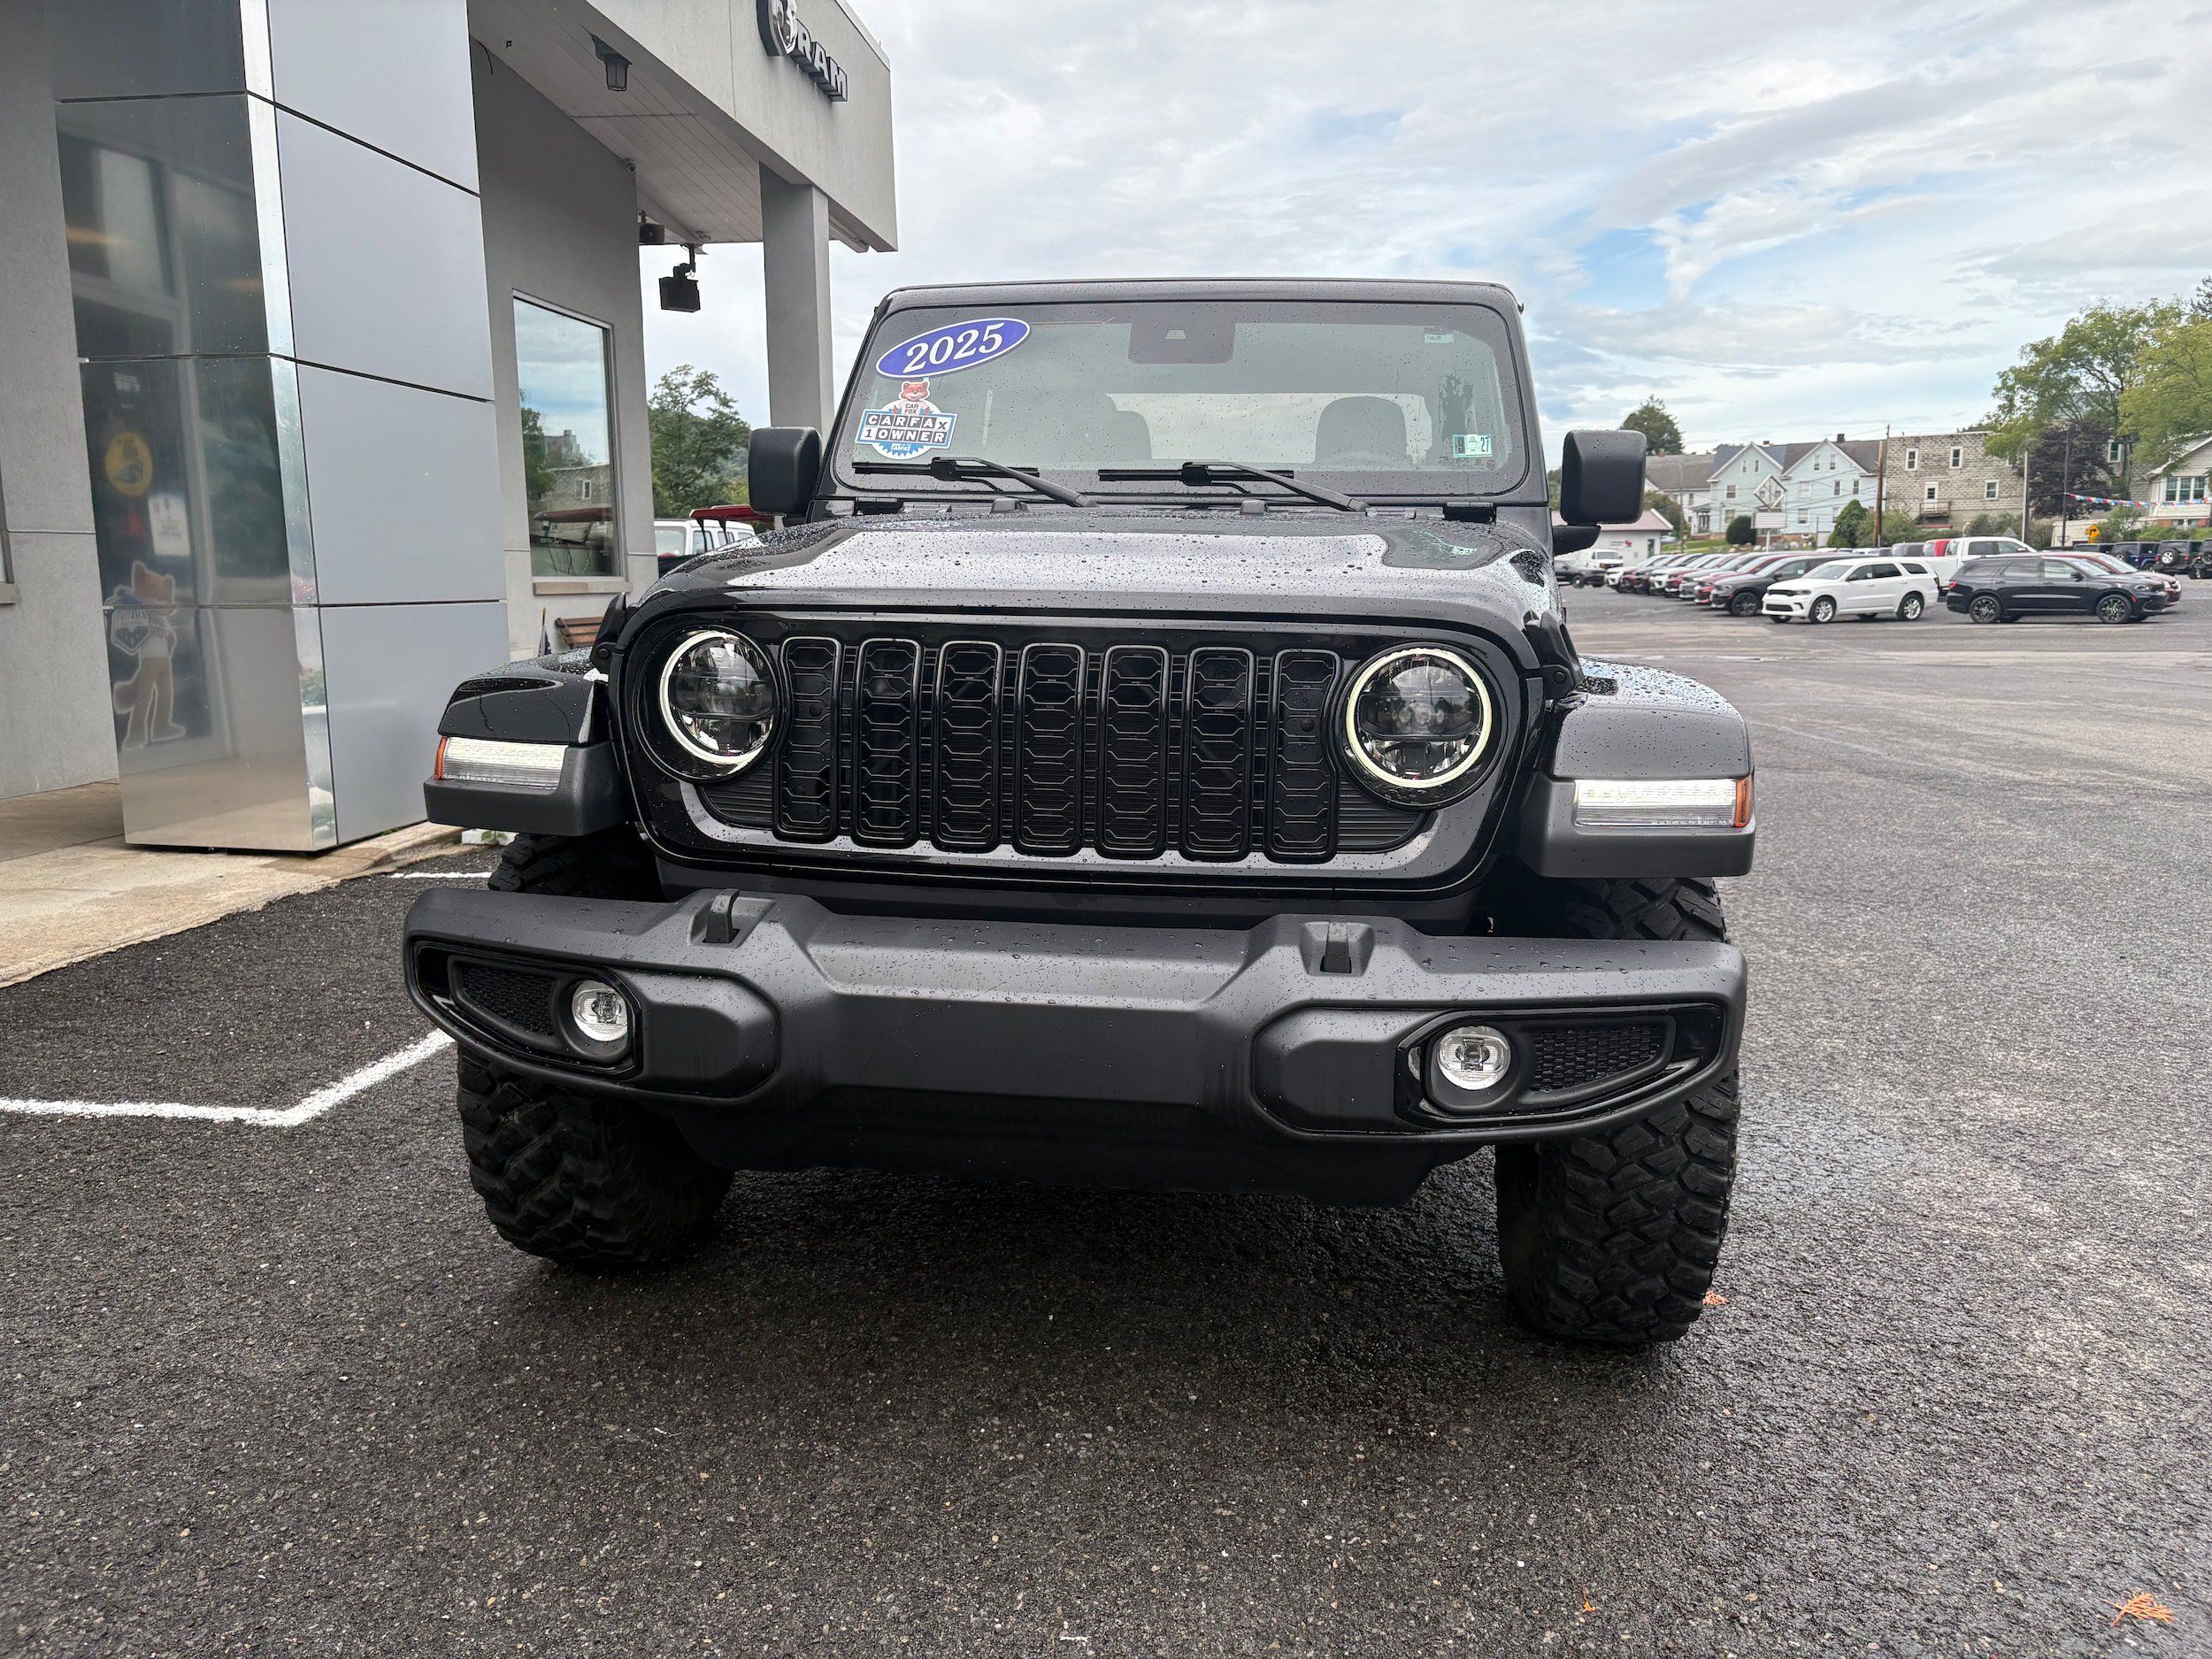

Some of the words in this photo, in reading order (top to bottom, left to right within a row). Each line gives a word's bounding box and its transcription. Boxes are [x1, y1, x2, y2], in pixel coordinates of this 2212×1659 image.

[796, 19, 848, 102] RAM
[902, 322, 1005, 373] 2025
[867, 414, 949, 430] CARFAX
[878, 429, 946, 442] OWNER
[1480, 436, 1489, 453] 27
